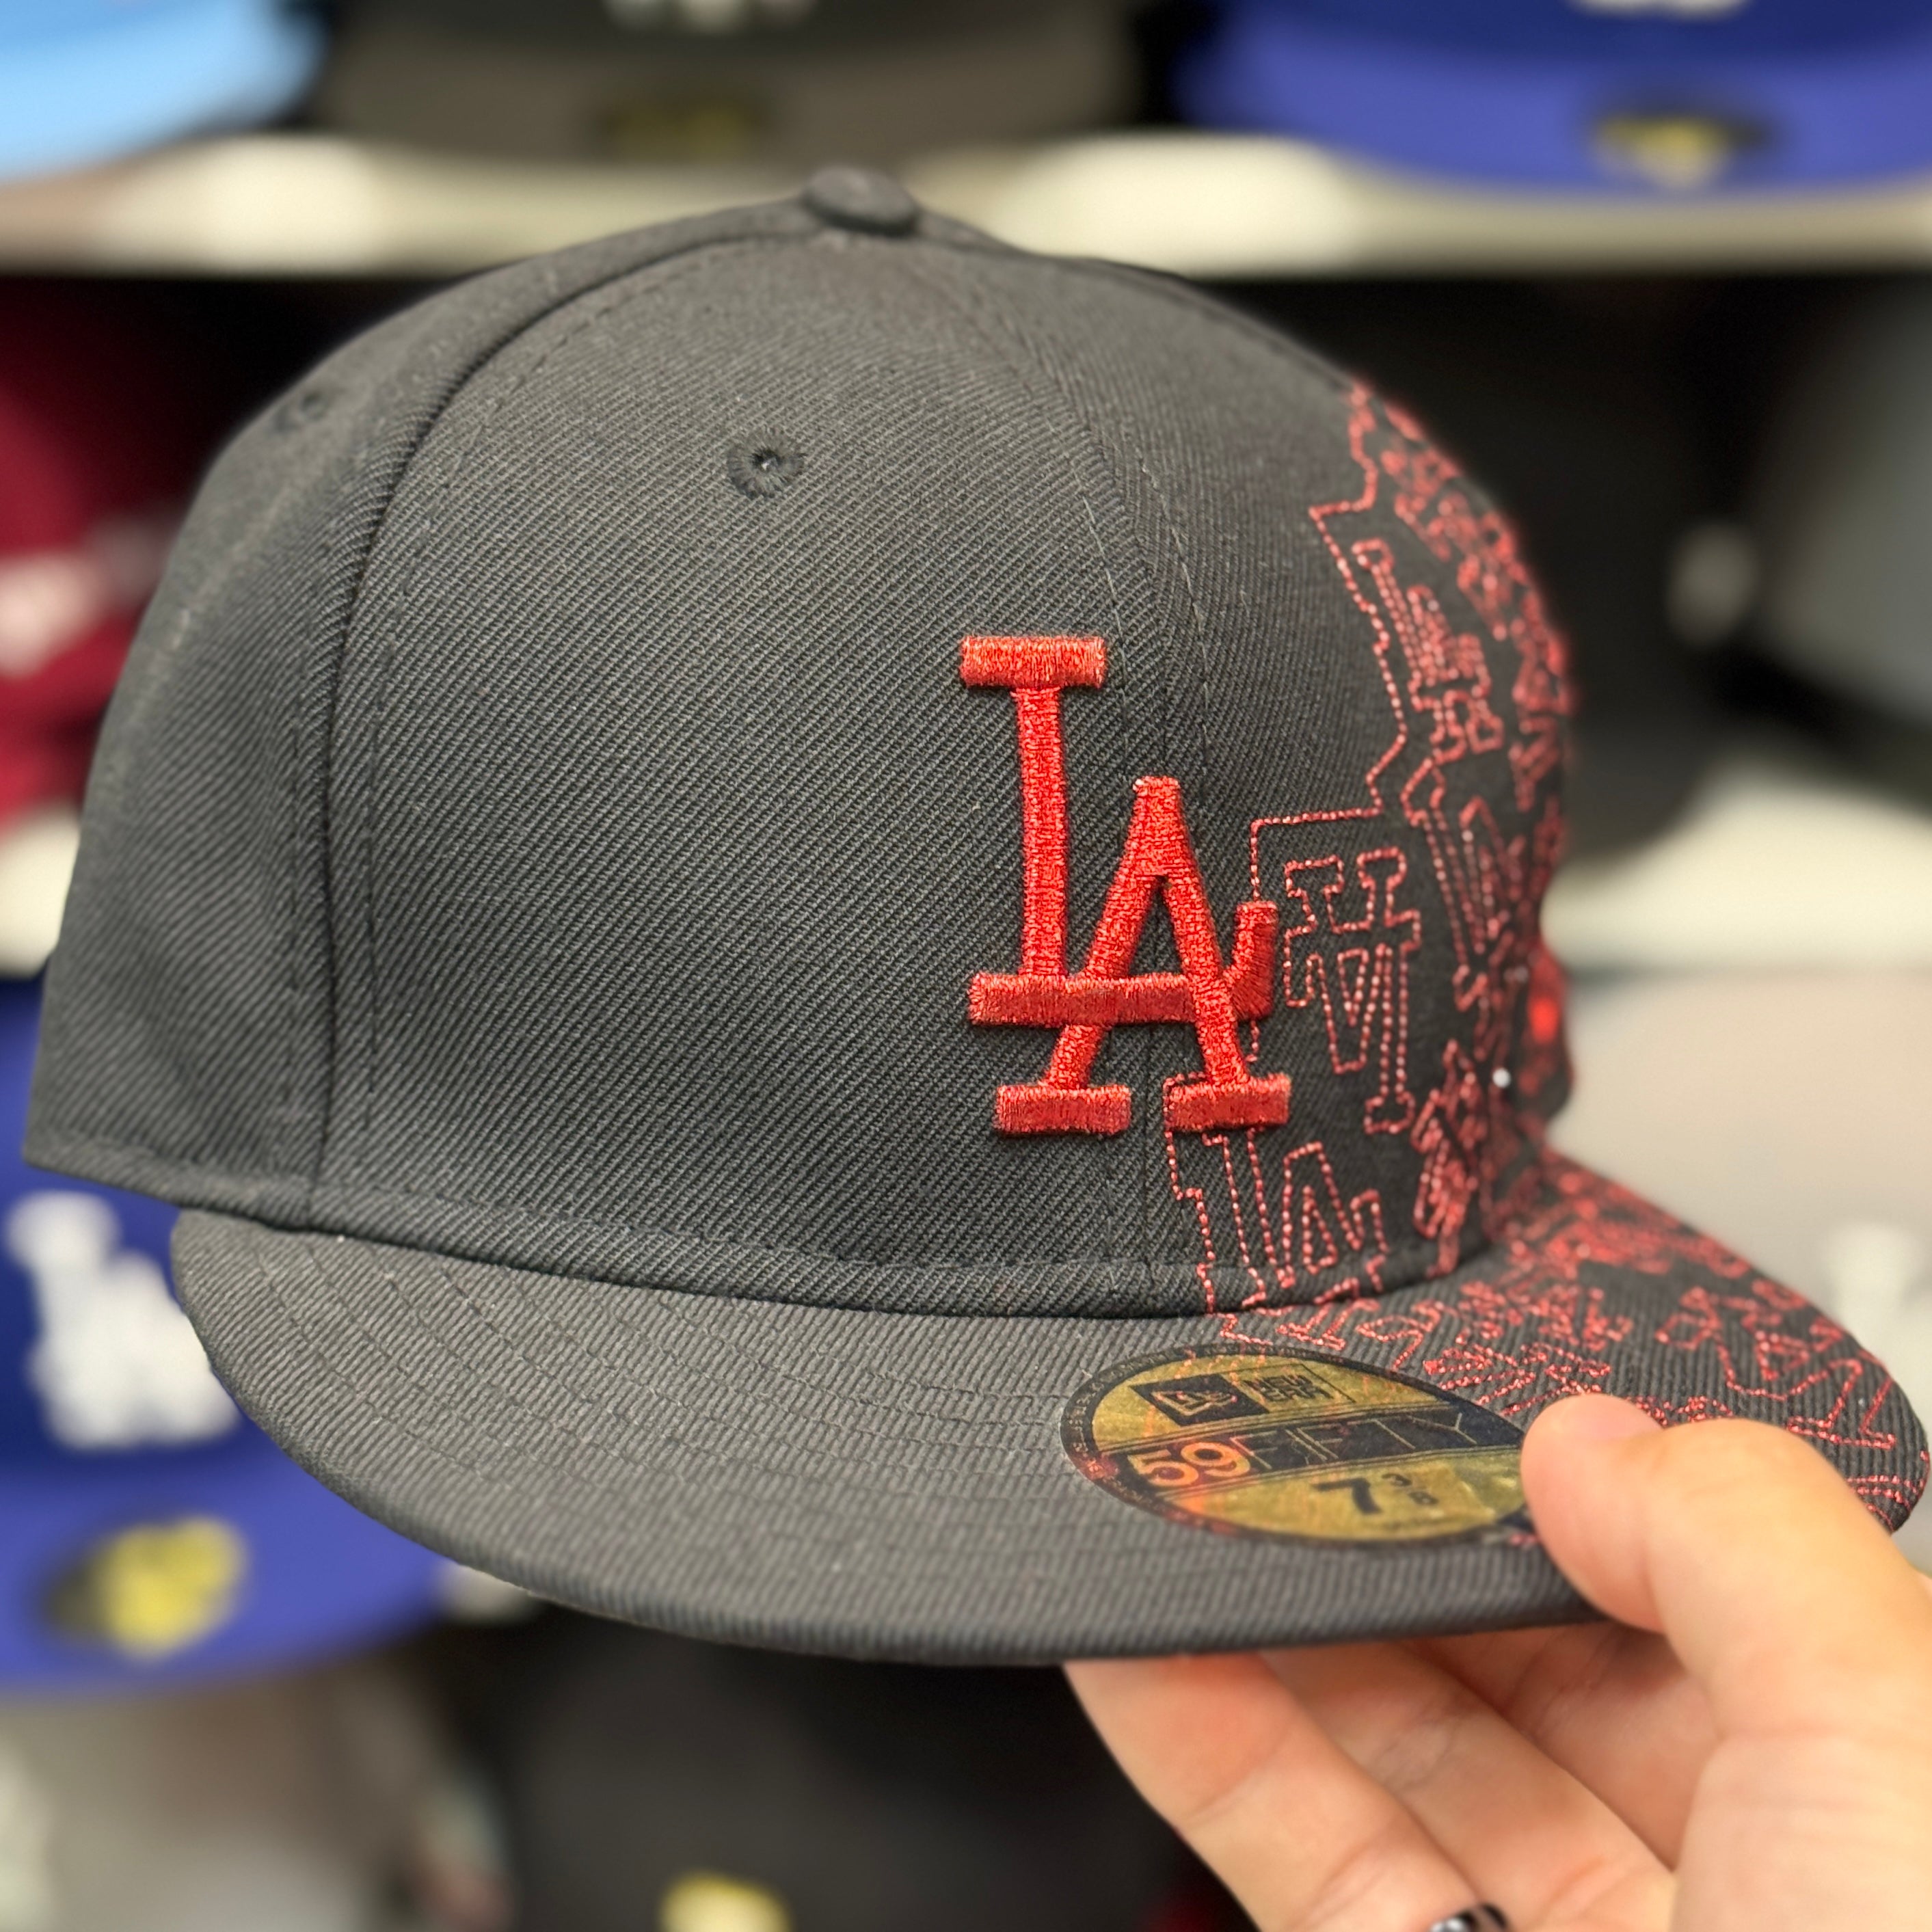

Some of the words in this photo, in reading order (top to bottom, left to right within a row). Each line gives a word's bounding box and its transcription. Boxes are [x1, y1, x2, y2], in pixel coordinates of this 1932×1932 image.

[958, 634, 1291, 1134] LA
[1242, 1374, 1313, 1393] NEW
[1261, 1384, 1334, 1401] ERA
